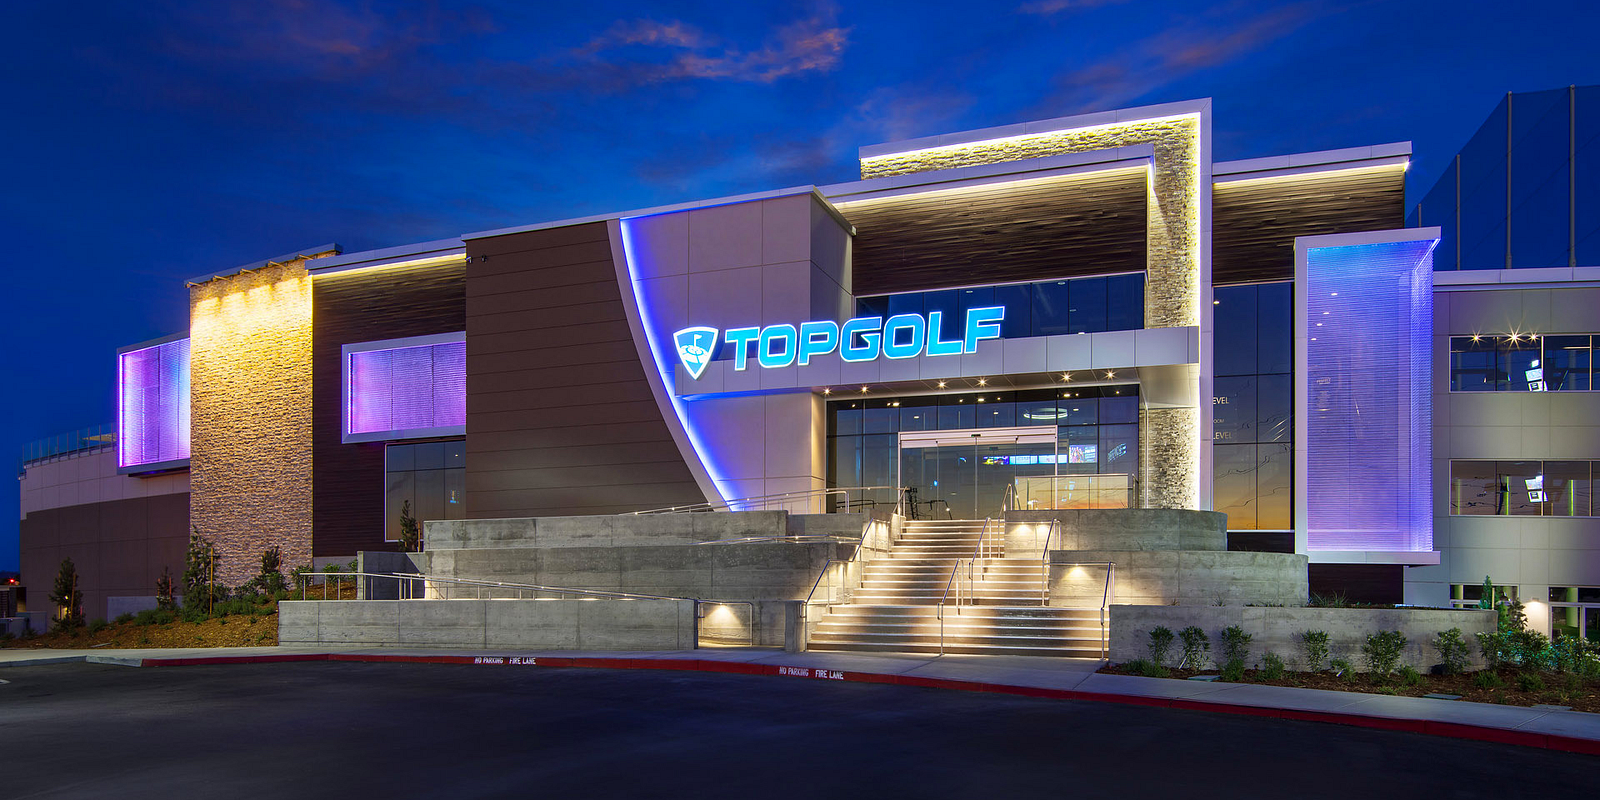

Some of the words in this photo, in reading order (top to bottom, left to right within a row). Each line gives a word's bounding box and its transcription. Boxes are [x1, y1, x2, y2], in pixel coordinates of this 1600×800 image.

[725, 306, 1005, 371] TOPGOLF
[474, 656, 482, 664] NO
[483, 656, 504, 664] PARKING
[509, 657, 521, 665] FIRE
[522, 657, 536, 665] LANE
[779, 666, 787, 675] NO
[788, 667, 809, 677] PARKING
[815, 669, 828, 679] FIRE
[829, 670, 844, 680] LANE
